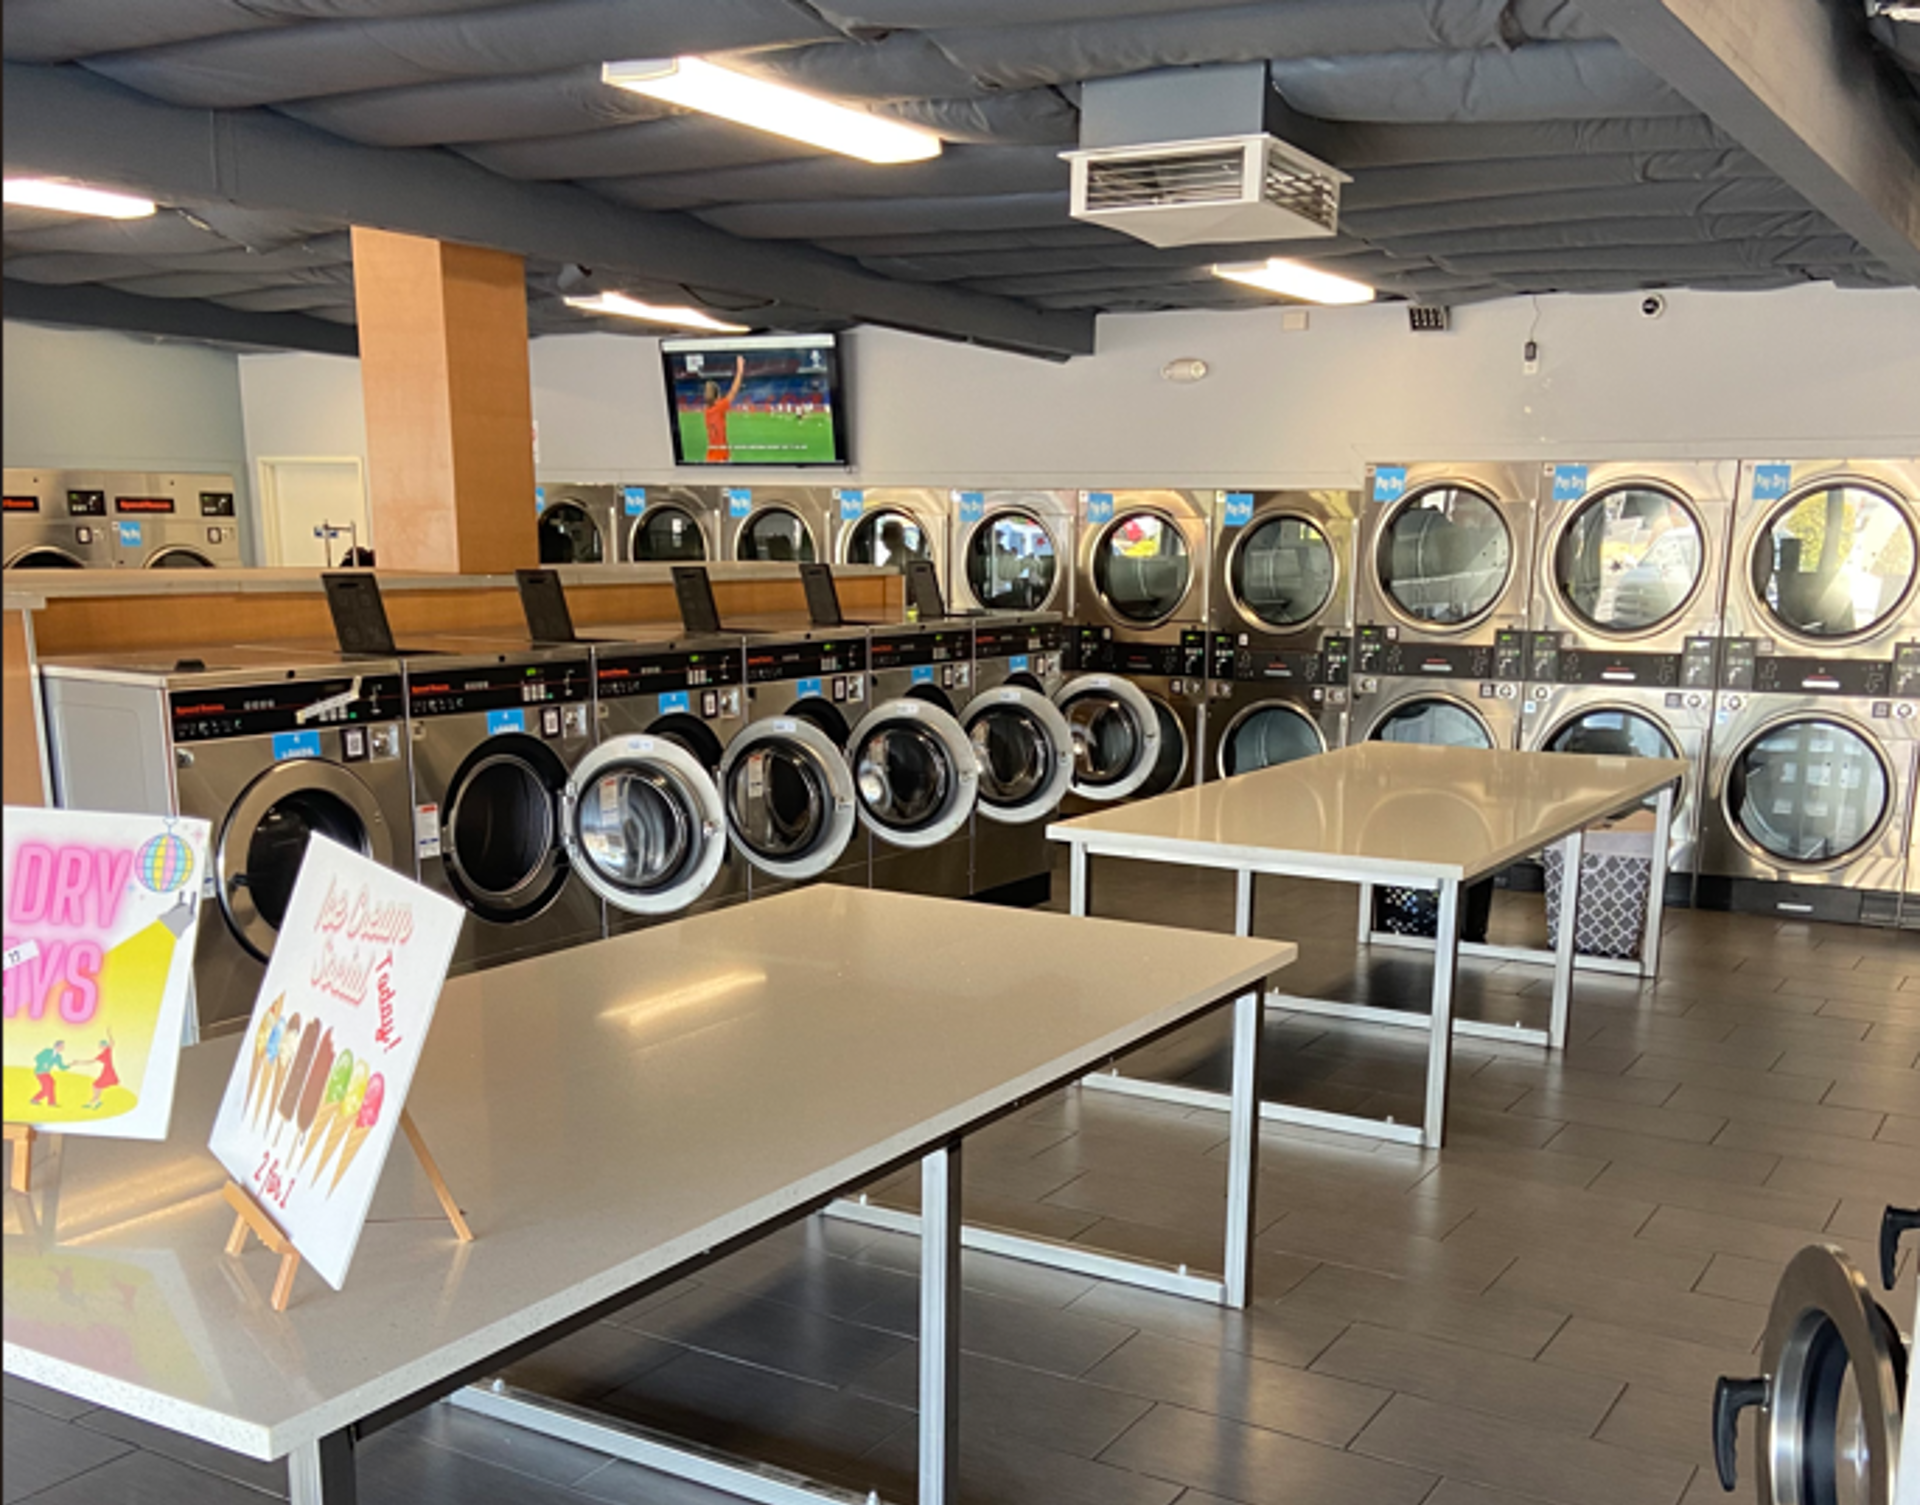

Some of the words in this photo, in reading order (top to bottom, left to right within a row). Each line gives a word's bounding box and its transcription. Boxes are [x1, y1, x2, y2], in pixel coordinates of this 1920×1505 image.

[8, 842, 134, 929] DRY
[375, 948, 403, 1054] Today!
[253, 1149, 270, 1182] 2
